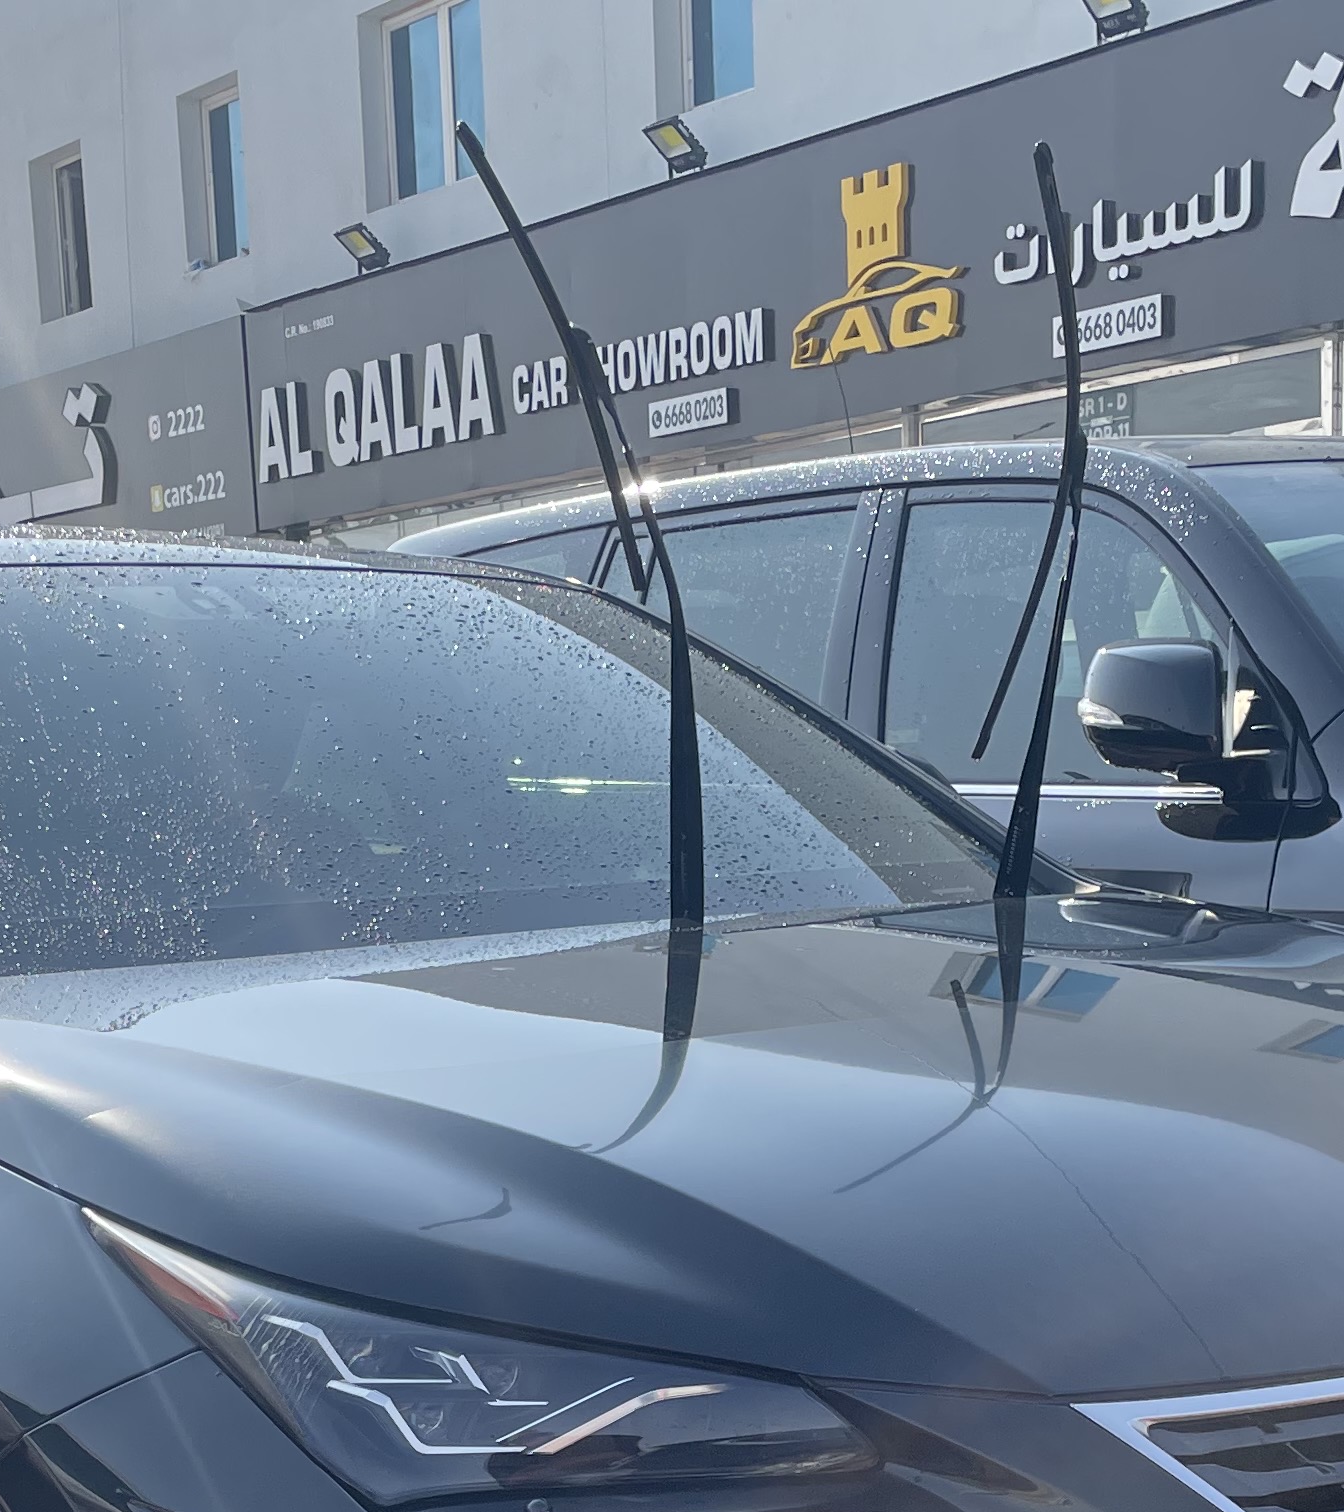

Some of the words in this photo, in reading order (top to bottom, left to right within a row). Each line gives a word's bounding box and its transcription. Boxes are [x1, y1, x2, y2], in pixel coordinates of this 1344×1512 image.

[820, 287, 954, 365] AQ
[1116, 302, 1157, 336] 0403
[259, 381, 313, 483] AL
[325, 333, 495, 467] QALAA
[512, 356, 568, 414] CAR
[577, 307, 764, 398] HOWROOM
[664, 402, 692, 429] 6668
[694, 395, 724, 423] 0203
[1117, 392, 1127, 411] D
[167, 404, 205, 437] 2222
[164, 470, 226, 508] cars.222
